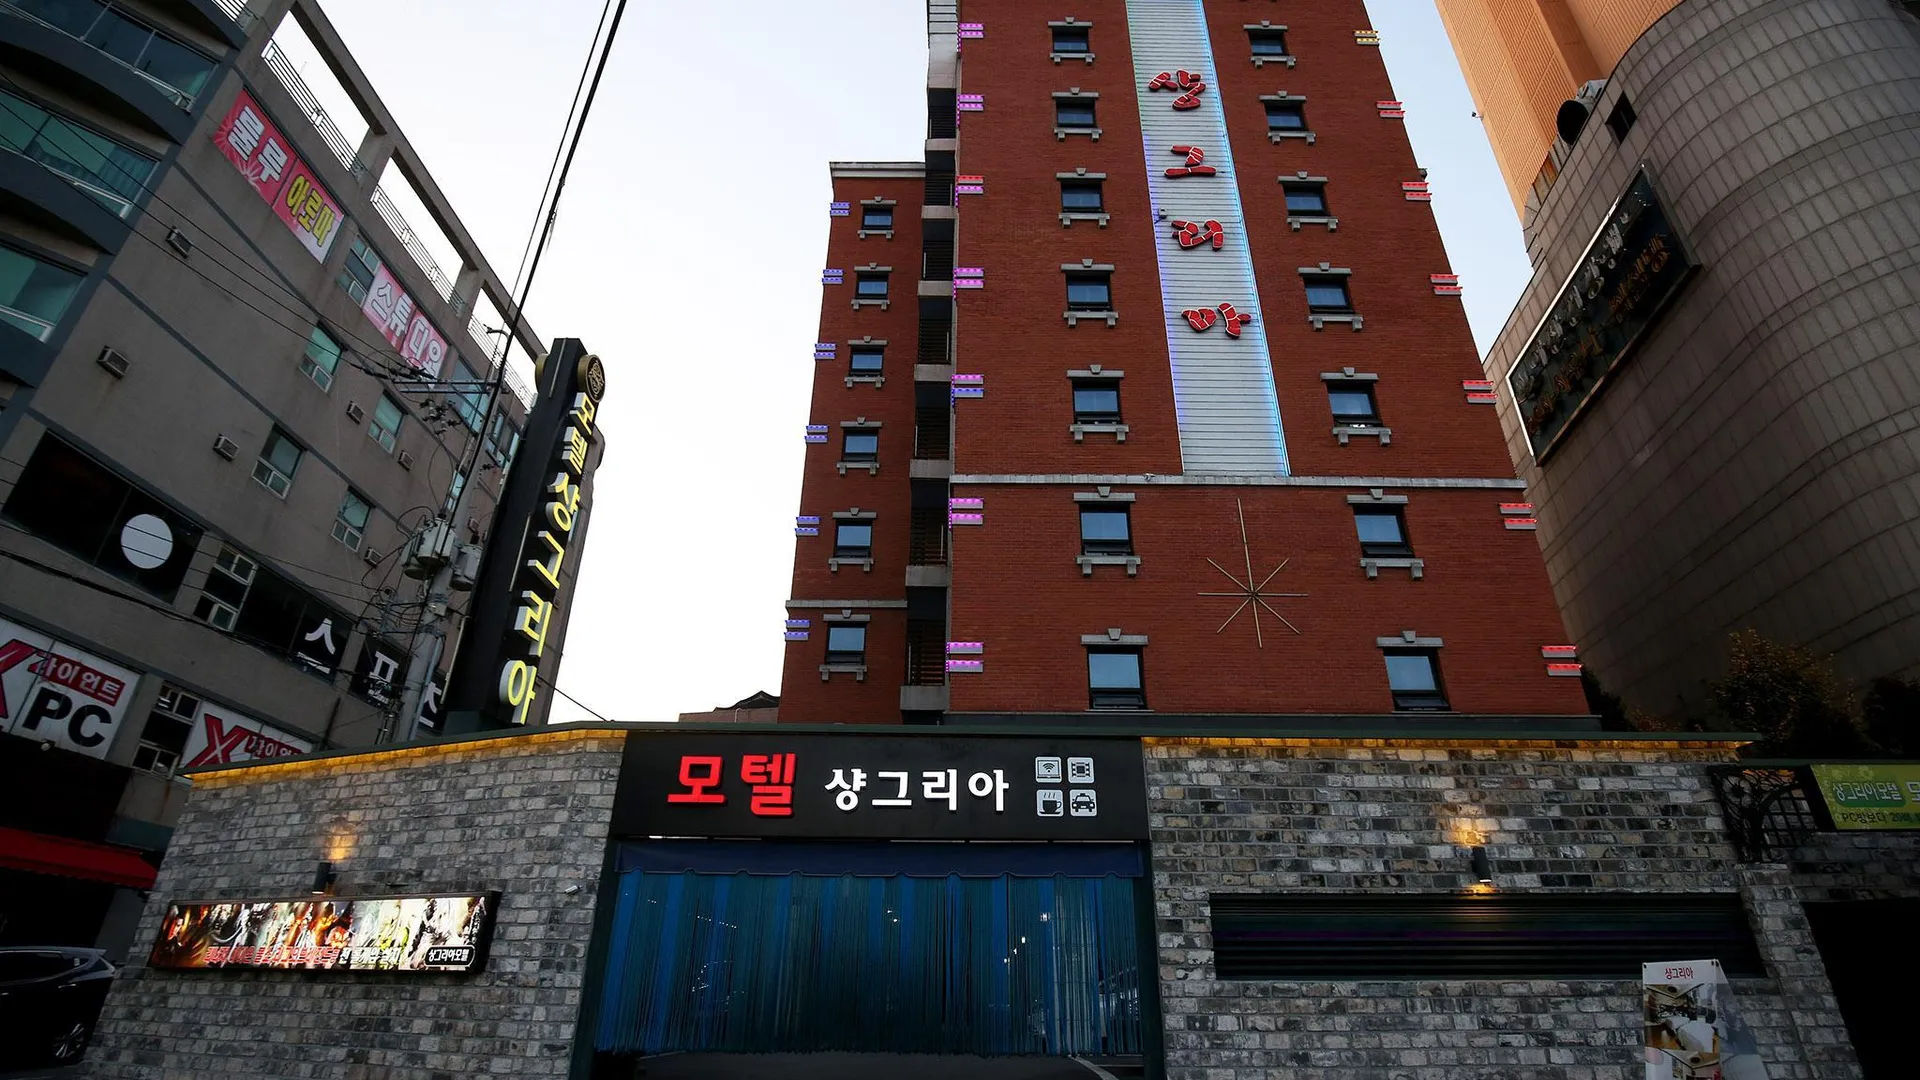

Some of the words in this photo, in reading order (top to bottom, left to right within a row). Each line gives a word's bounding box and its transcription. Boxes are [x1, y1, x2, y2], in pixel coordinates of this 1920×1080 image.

[285, 173, 337, 248] 아로마
[371, 282, 442, 389] 스튜디오
[22, 687, 112, 748] PC
[666, 753, 799, 817] 모텔
[824, 767, 1010, 813] 샹그리아
